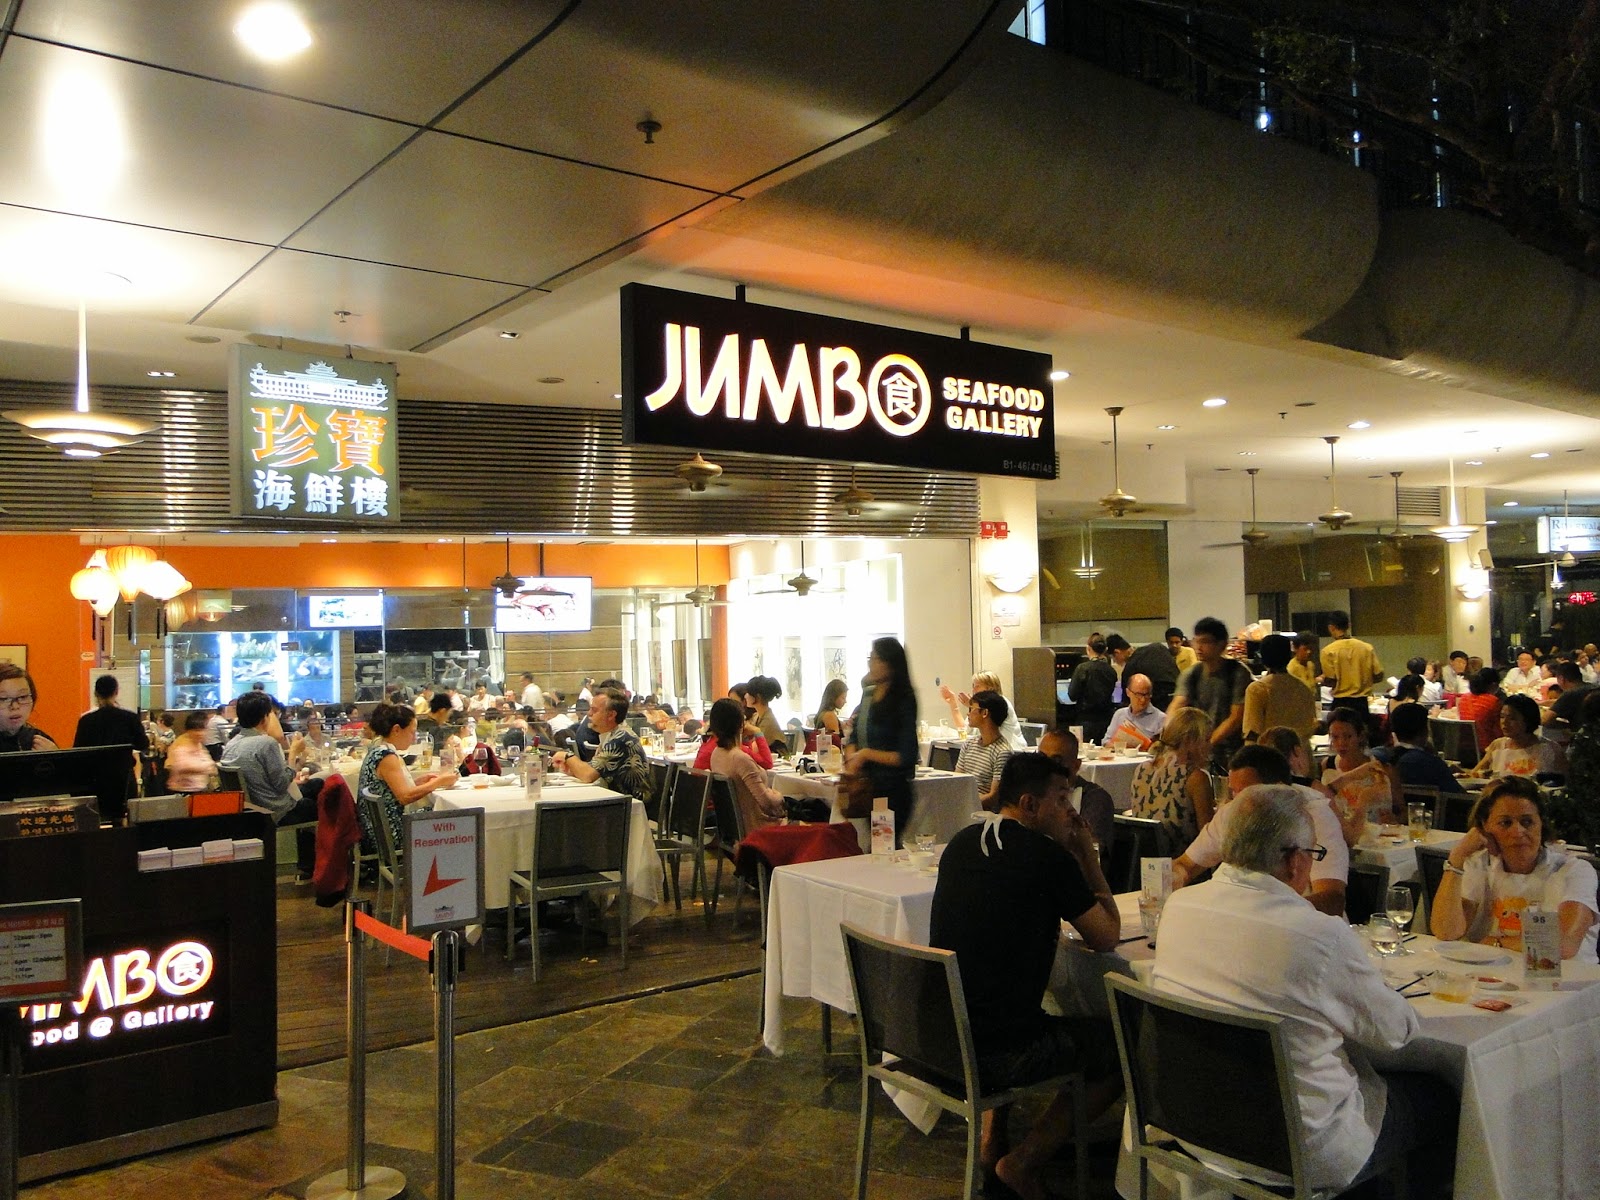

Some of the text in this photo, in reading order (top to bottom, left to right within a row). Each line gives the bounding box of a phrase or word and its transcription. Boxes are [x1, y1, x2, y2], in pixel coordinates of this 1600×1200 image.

[645, 322, 931, 437] JUMBO
[881, 371, 917, 419] 食
[943, 376, 1045, 411] SEAFOOD
[251, 403, 387, 476] 珍寶
[945, 405, 1043, 439] GALLERY
[253, 469, 388, 517] 海鮮樓
[414, 834, 475, 849] Reservation
[432, 822, 456, 833] With
[123, 1001, 214, 1030] Gallery
